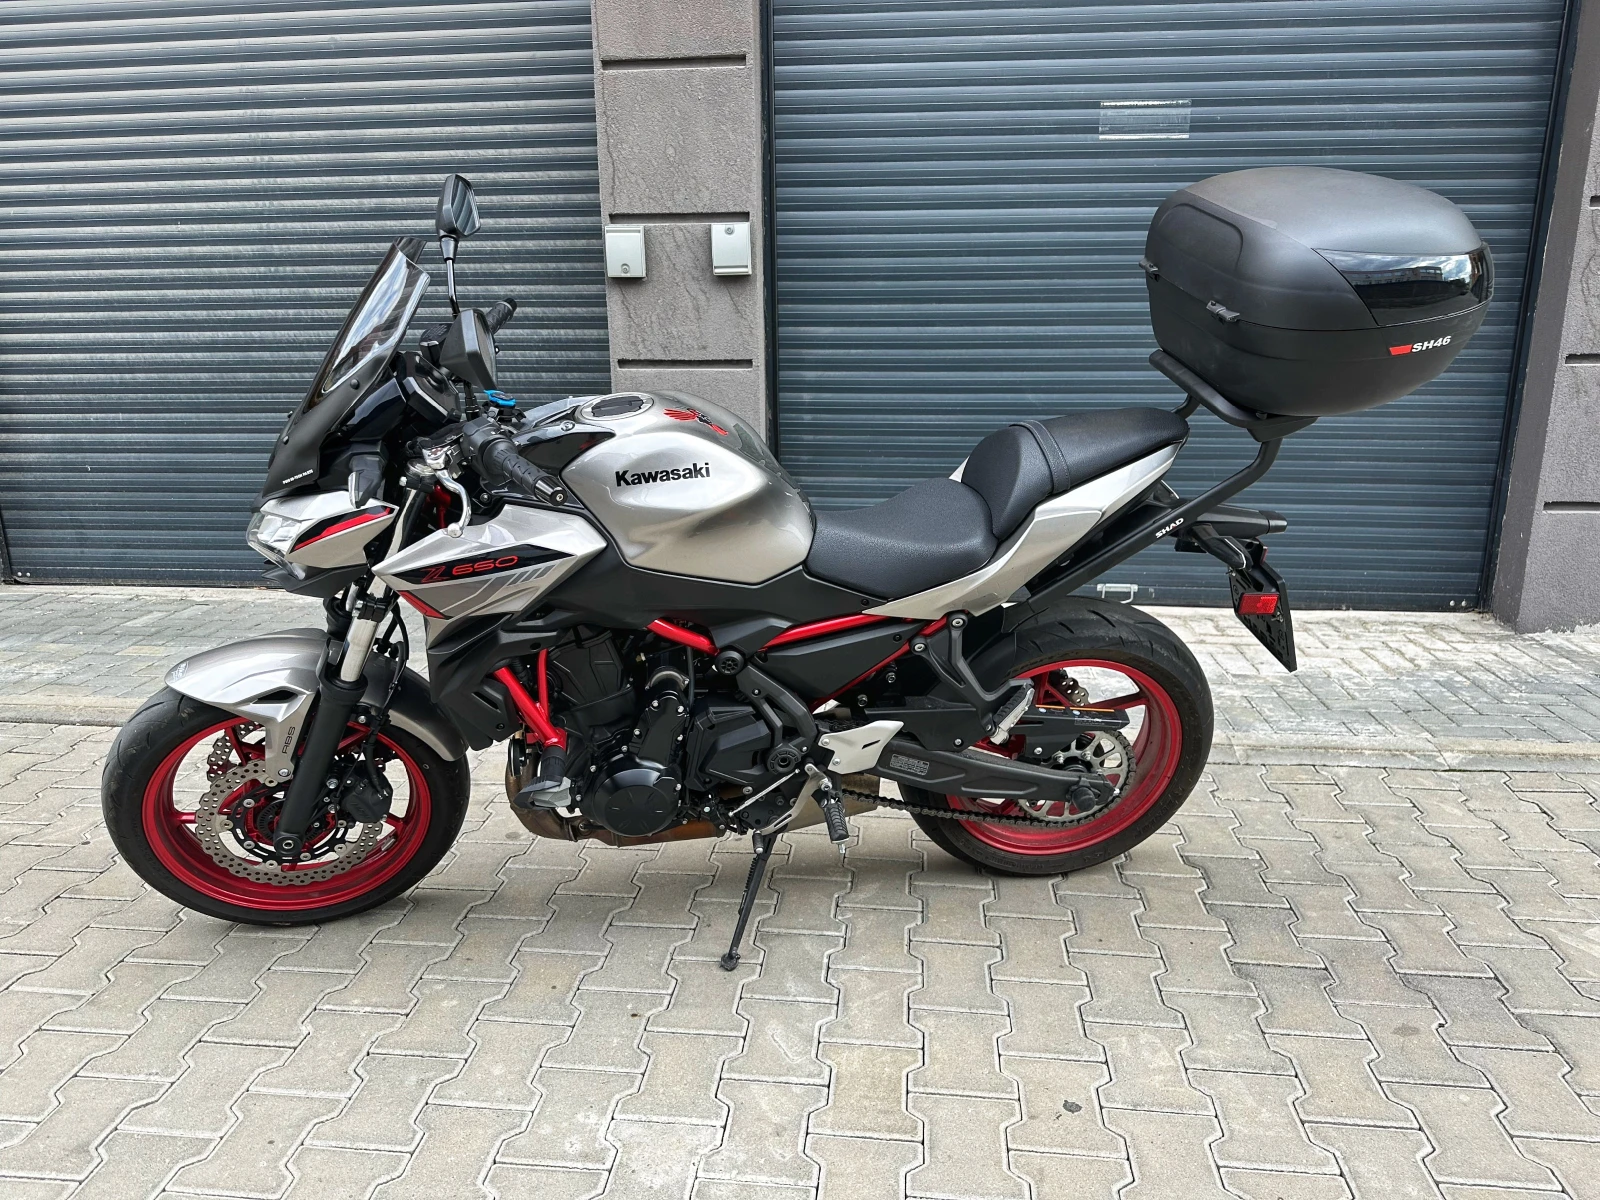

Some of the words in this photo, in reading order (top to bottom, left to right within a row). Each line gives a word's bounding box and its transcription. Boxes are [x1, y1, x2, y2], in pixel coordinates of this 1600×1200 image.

[1411, 335, 1452, 353] SH46
[615, 462, 711, 487] Kawasaki
[1155, 517, 1184, 539] SHAD
[281, 726, 296, 755] ABS
